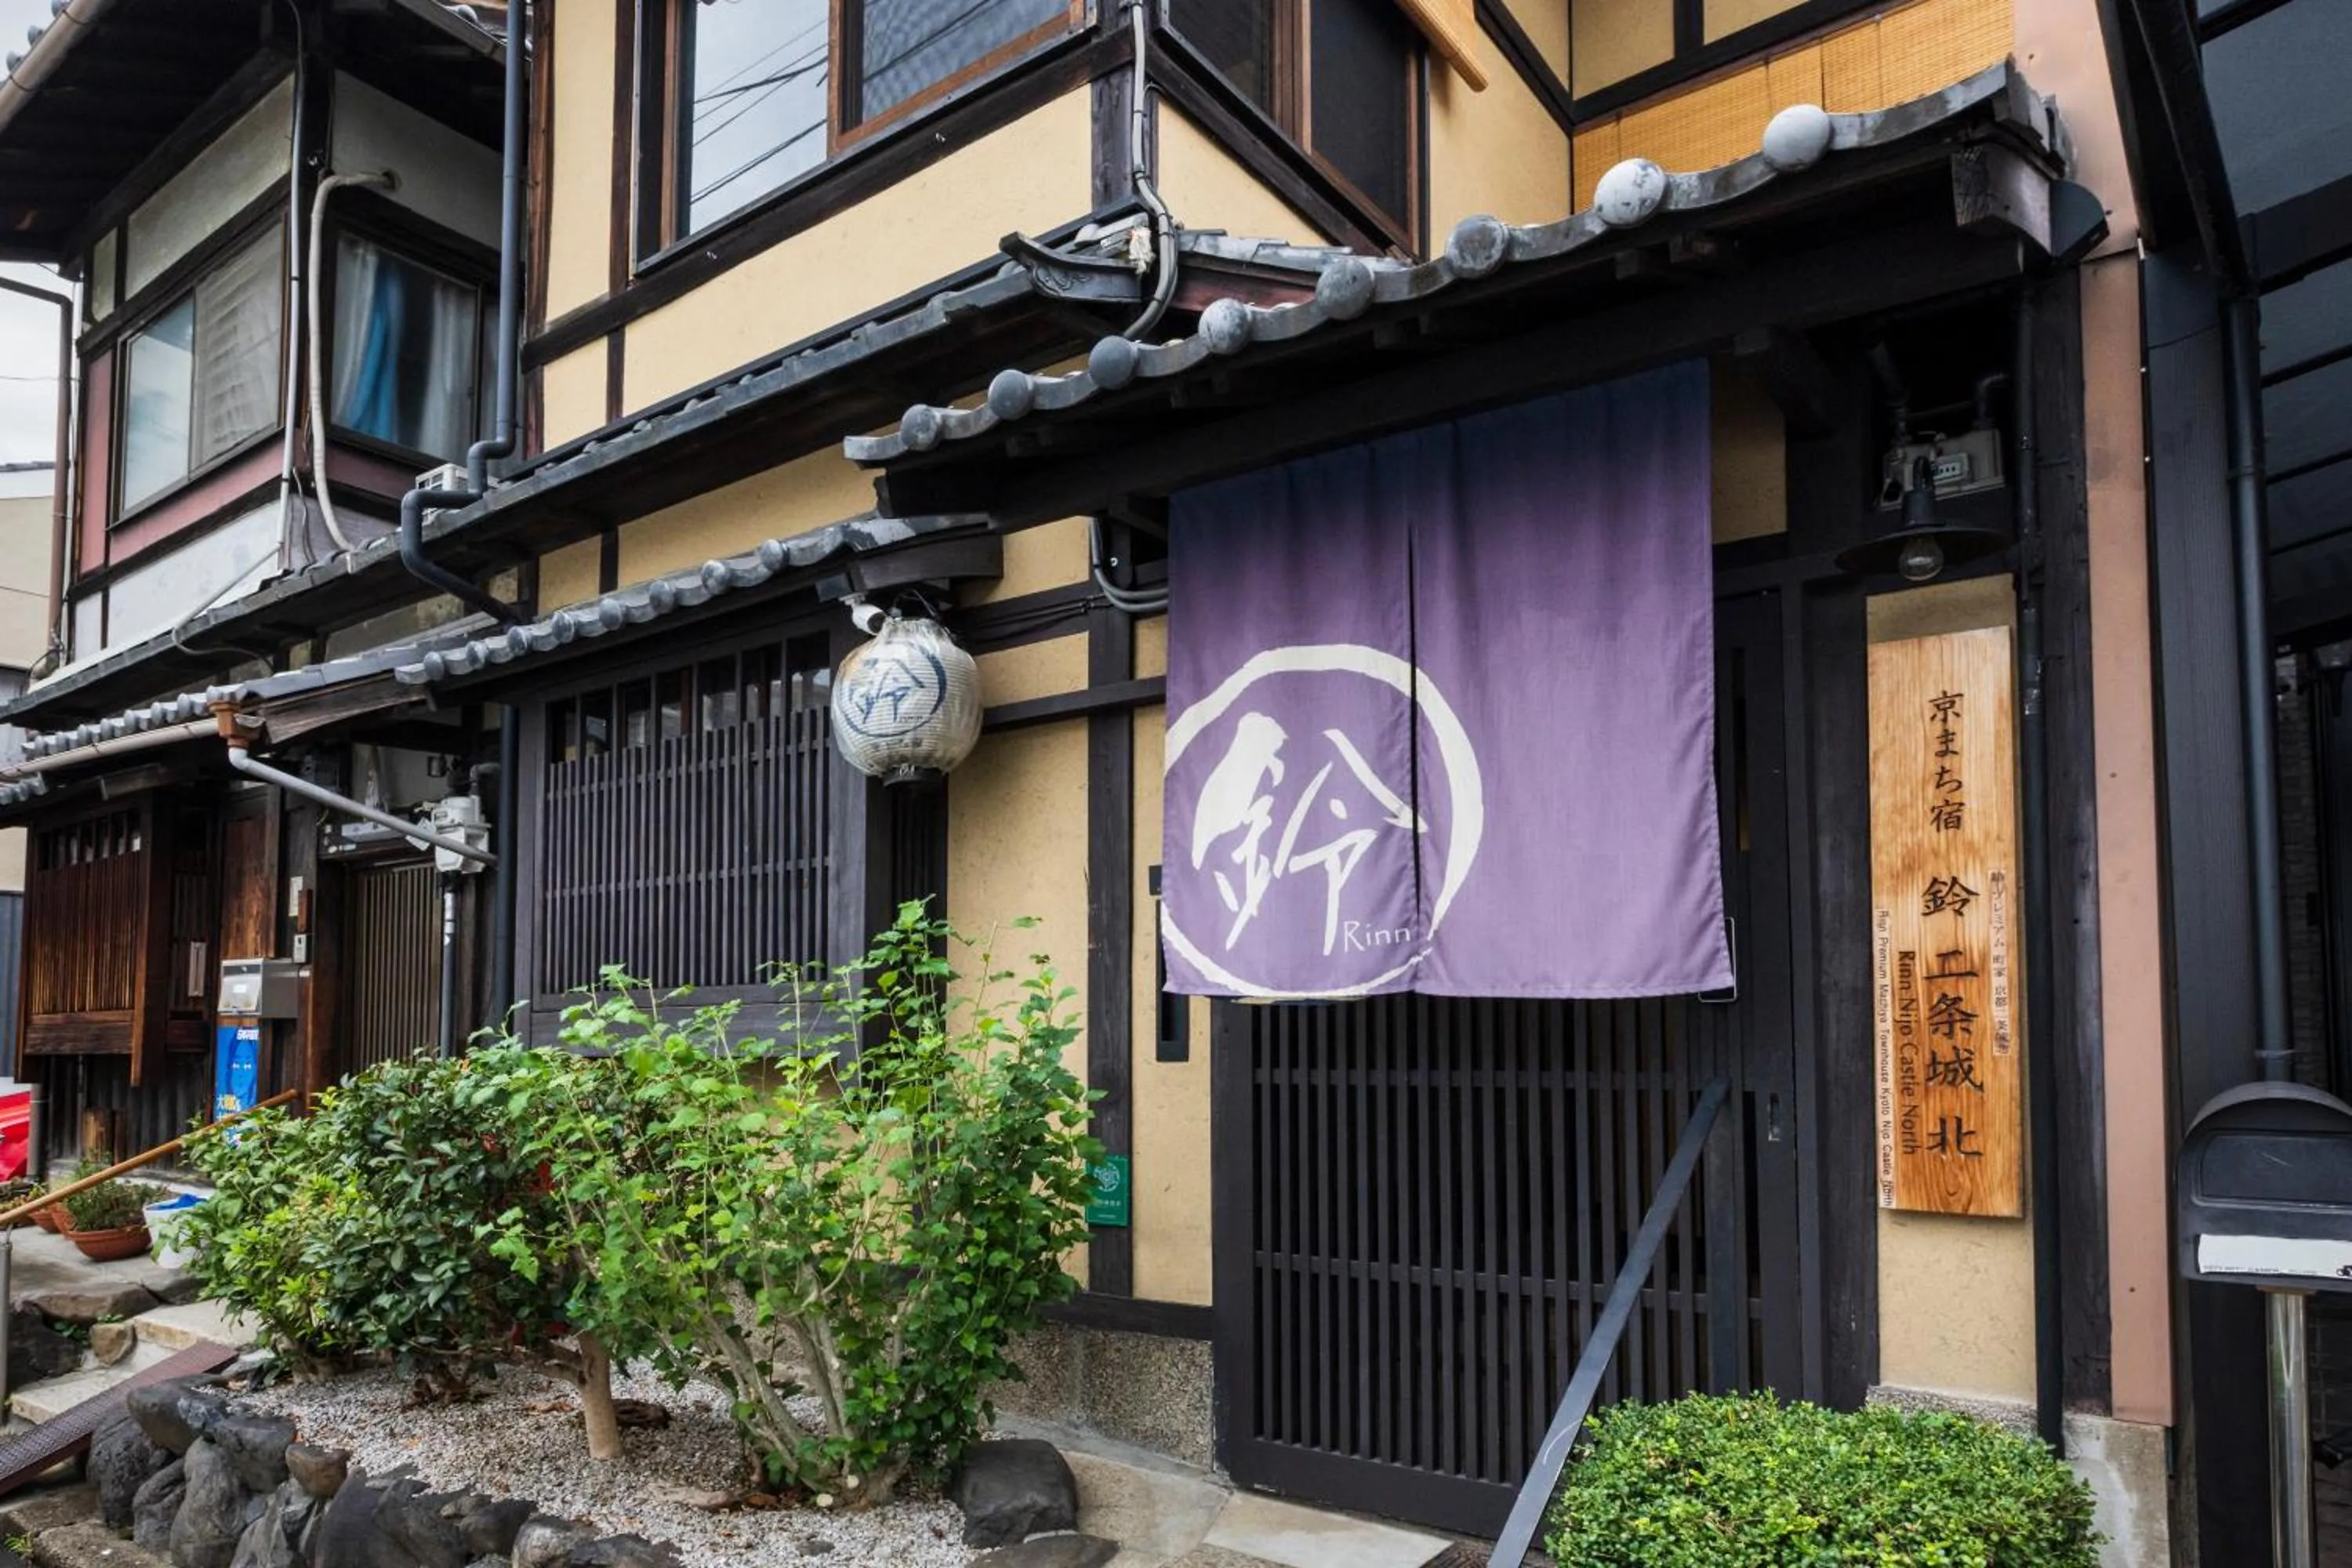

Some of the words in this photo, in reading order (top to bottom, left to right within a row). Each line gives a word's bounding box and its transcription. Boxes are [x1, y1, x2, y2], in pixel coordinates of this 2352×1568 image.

[1929, 690, 1967, 833] 京まち宿
[1344, 920, 1410, 953] Rinn
[1878, 938, 1889, 979] Premium
[1898, 950, 1916, 990] Rinn
[1878, 984, 1889, 1023] Machiya
[1893, 998, 1918, 1036] Nijo
[1880, 1029, 1889, 1083] Townhouse
[1900, 1042, 1919, 1097] Castle
[1881, 1087, 1891, 1115] Kyoto
[1900, 1105, 1919, 1156] North
[1882, 1146, 1893, 1175] Castle
